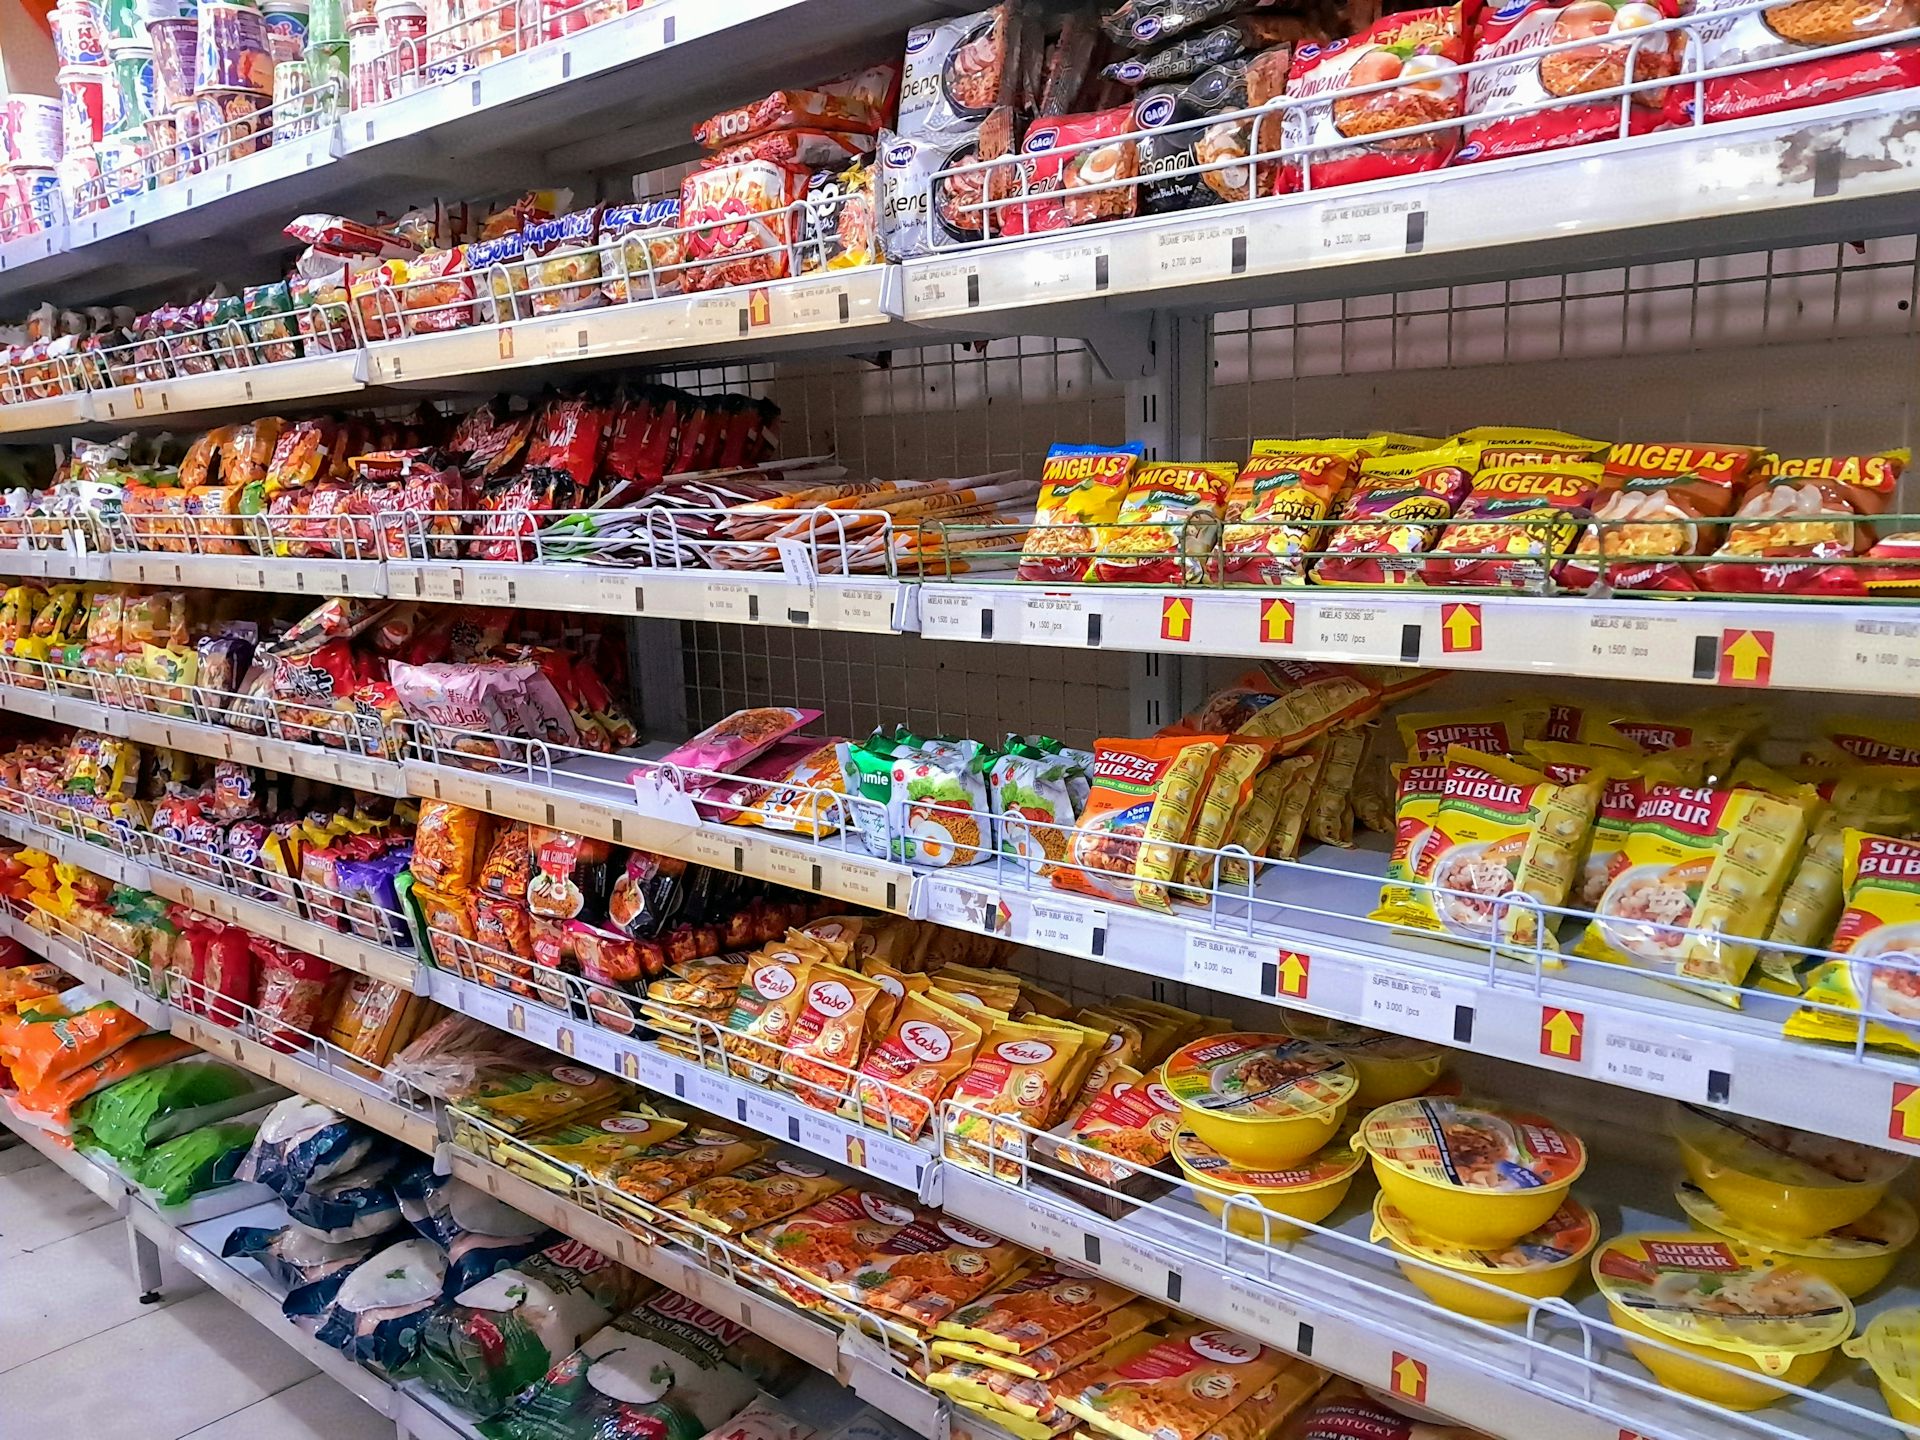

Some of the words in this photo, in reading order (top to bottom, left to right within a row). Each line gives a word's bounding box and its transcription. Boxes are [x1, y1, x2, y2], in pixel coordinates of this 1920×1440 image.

[1243, 456, 1331, 476] MIGELAS
[1608, 443, 1739, 472] MIGELAS
[1042, 457, 1122, 480] MIGELAS
[1132, 469, 1222, 495] MIGELAS
[1320, 610, 1342, 620] MIGELAS
[1345, 611, 1361, 621] SOSIS
[1321, 633, 1329, 643] Rp
[1352, 634, 1366, 644] /pcs
[1592, 645, 1602, 656] Rp
[1856, 652, 1868, 664] Rp
[1426, 726, 1495, 745] SUPER
[1099, 751, 1159, 772] SUPER
[1094, 762, 1154, 782] BUBUR
[1444, 779, 1523, 804] BUBUR
[1126, 806, 1150, 818] Abon
[1636, 800, 1712, 826] BUBUR
[1193, 939, 1207, 948] SUPER
[1209, 942, 1224, 952] BUBUR
[1194, 960, 1201, 970] Rp
[1221, 964, 1233, 975] /pcs
[1372, 976, 1390, 987] SUPER
[1391, 979, 1409, 992] BUBUR
[1412, 985, 1427, 996] SOTO
[811, 983, 848, 1010] Sasa
[1373, 1000, 1382, 1009] Rp
[1386, 1000, 1402, 1012] 3.000
[1406, 1004, 1420, 1016] /pcs
[904, 1026, 943, 1056] Sasa
[1002, 1042, 1044, 1060] Sasa
[1606, 1037, 1627, 1048] SUPER
[1608, 1062, 1617, 1072] Rp
[905, 1227, 942, 1249] KENTUCKY
[1650, 1243, 1720, 1256] SUPER
[1655, 1254, 1732, 1267] BUBUR
[648, 1288, 751, 1348] DAUN
[632, 1305, 670, 1330] BERAS
[668, 1322, 724, 1362] PREMIUM
[1318, 1417, 1397, 1438] KENTUCKY
